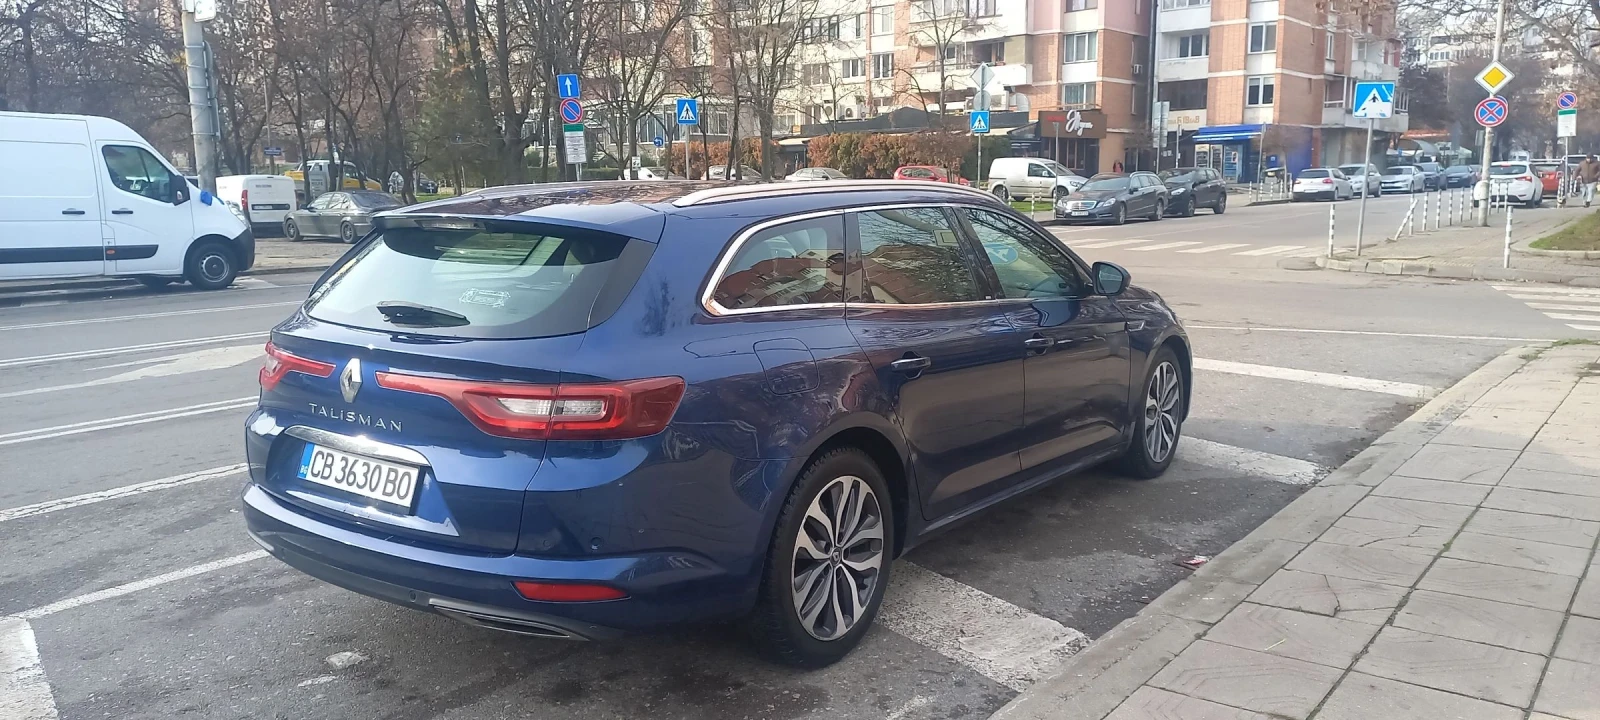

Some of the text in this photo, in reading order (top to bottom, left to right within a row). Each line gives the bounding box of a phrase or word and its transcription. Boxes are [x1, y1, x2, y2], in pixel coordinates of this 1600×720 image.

[310, 450, 412, 500] CB 3630 BO
